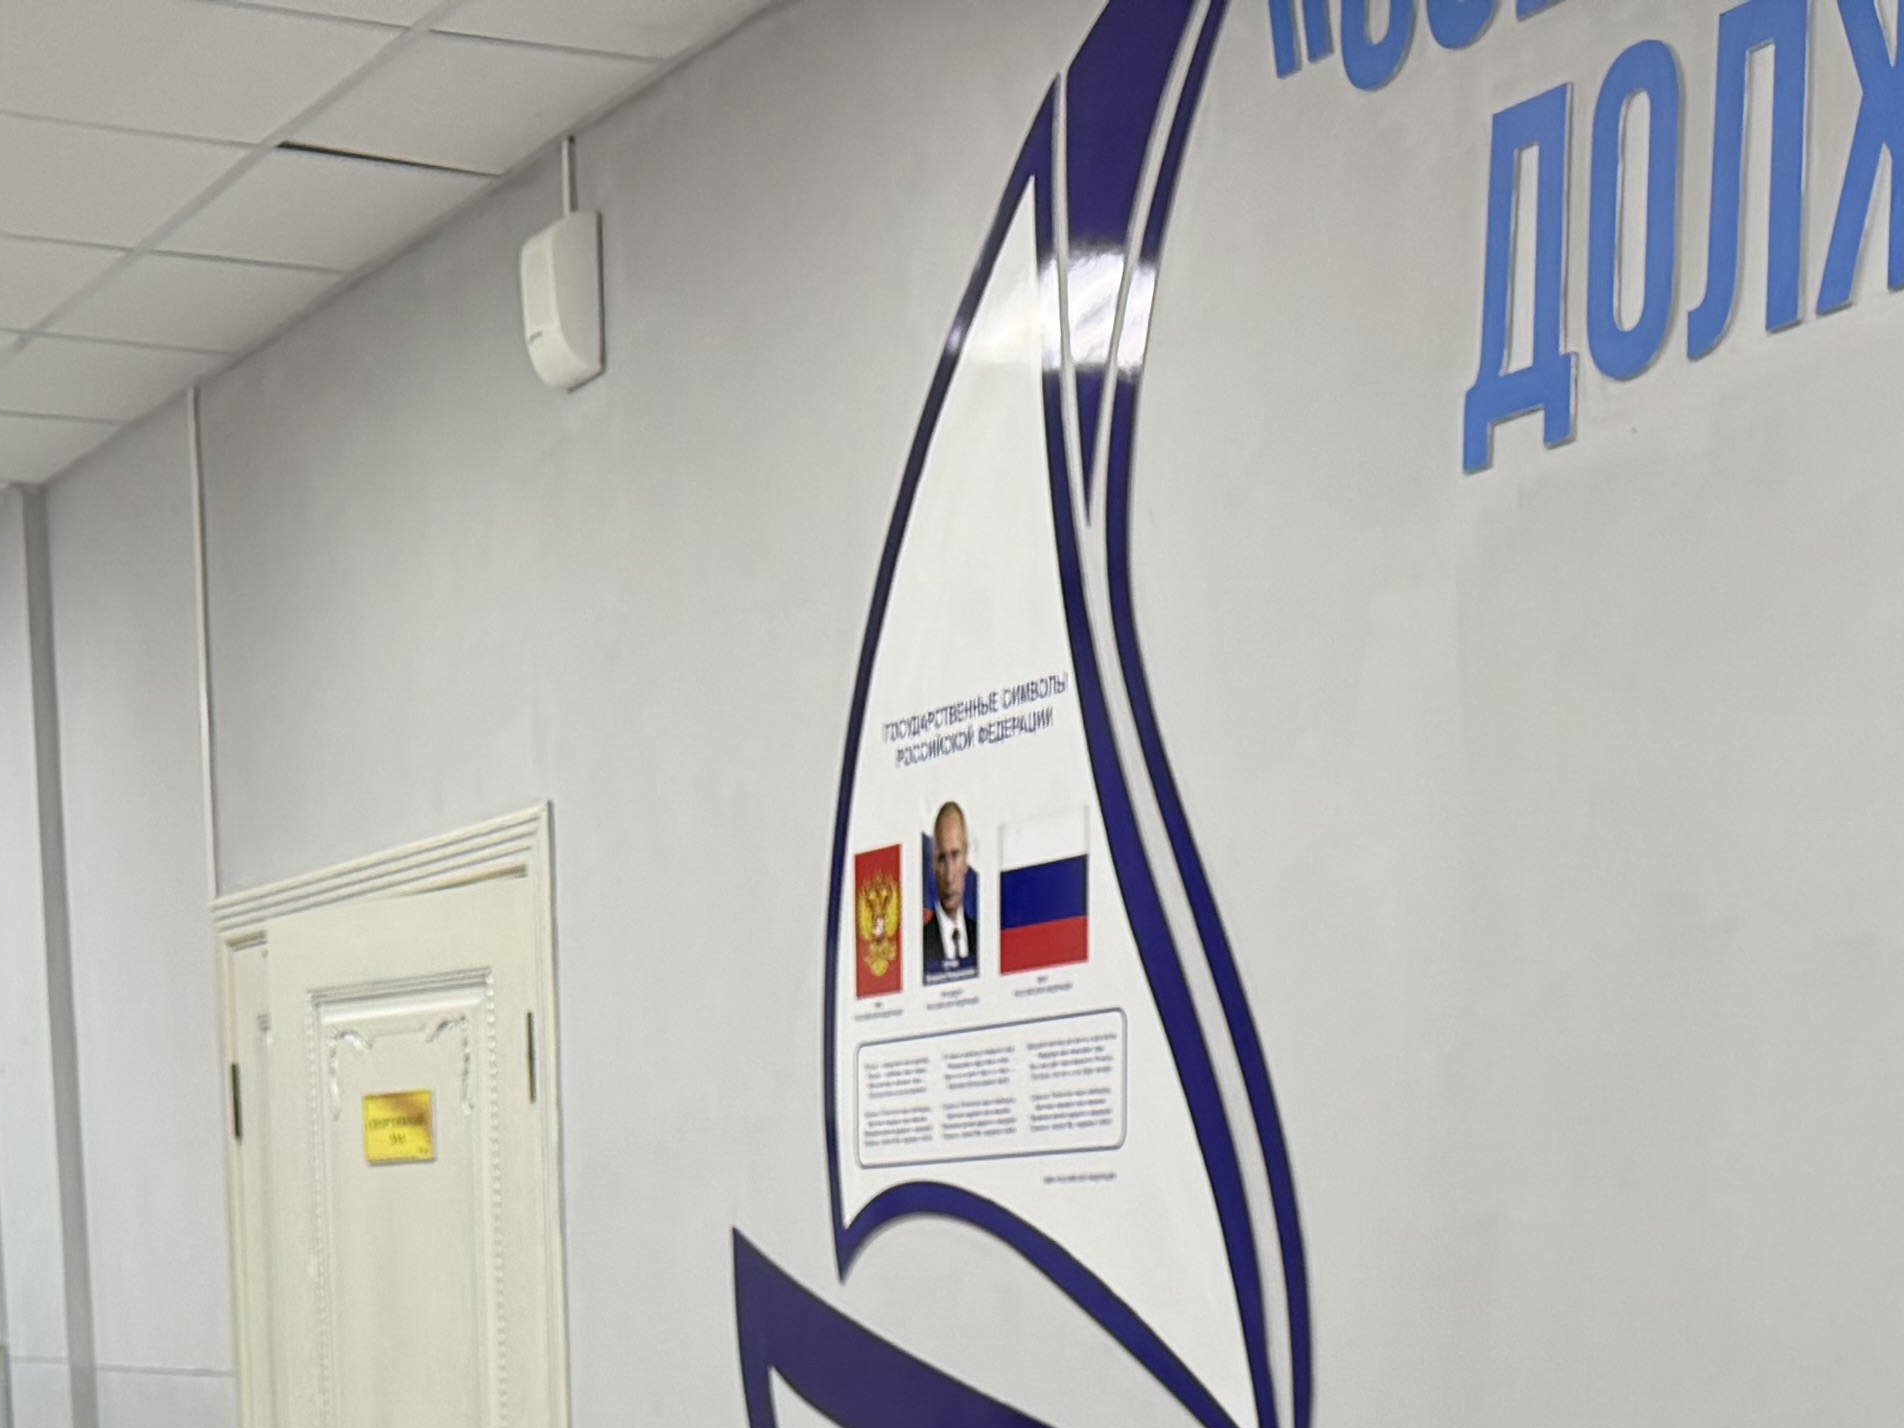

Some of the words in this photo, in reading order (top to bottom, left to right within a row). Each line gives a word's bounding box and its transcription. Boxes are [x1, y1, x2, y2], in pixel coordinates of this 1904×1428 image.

[882, 691, 1000, 744] ГОСУДАРСТВЕННЫЕ
[1003, 671, 1068, 709] СИМВОЛЫ
[896, 725, 975, 768] РОССИЙСКОЙ
[977, 706, 1054, 744] ФЕДЕРАЦИИ
